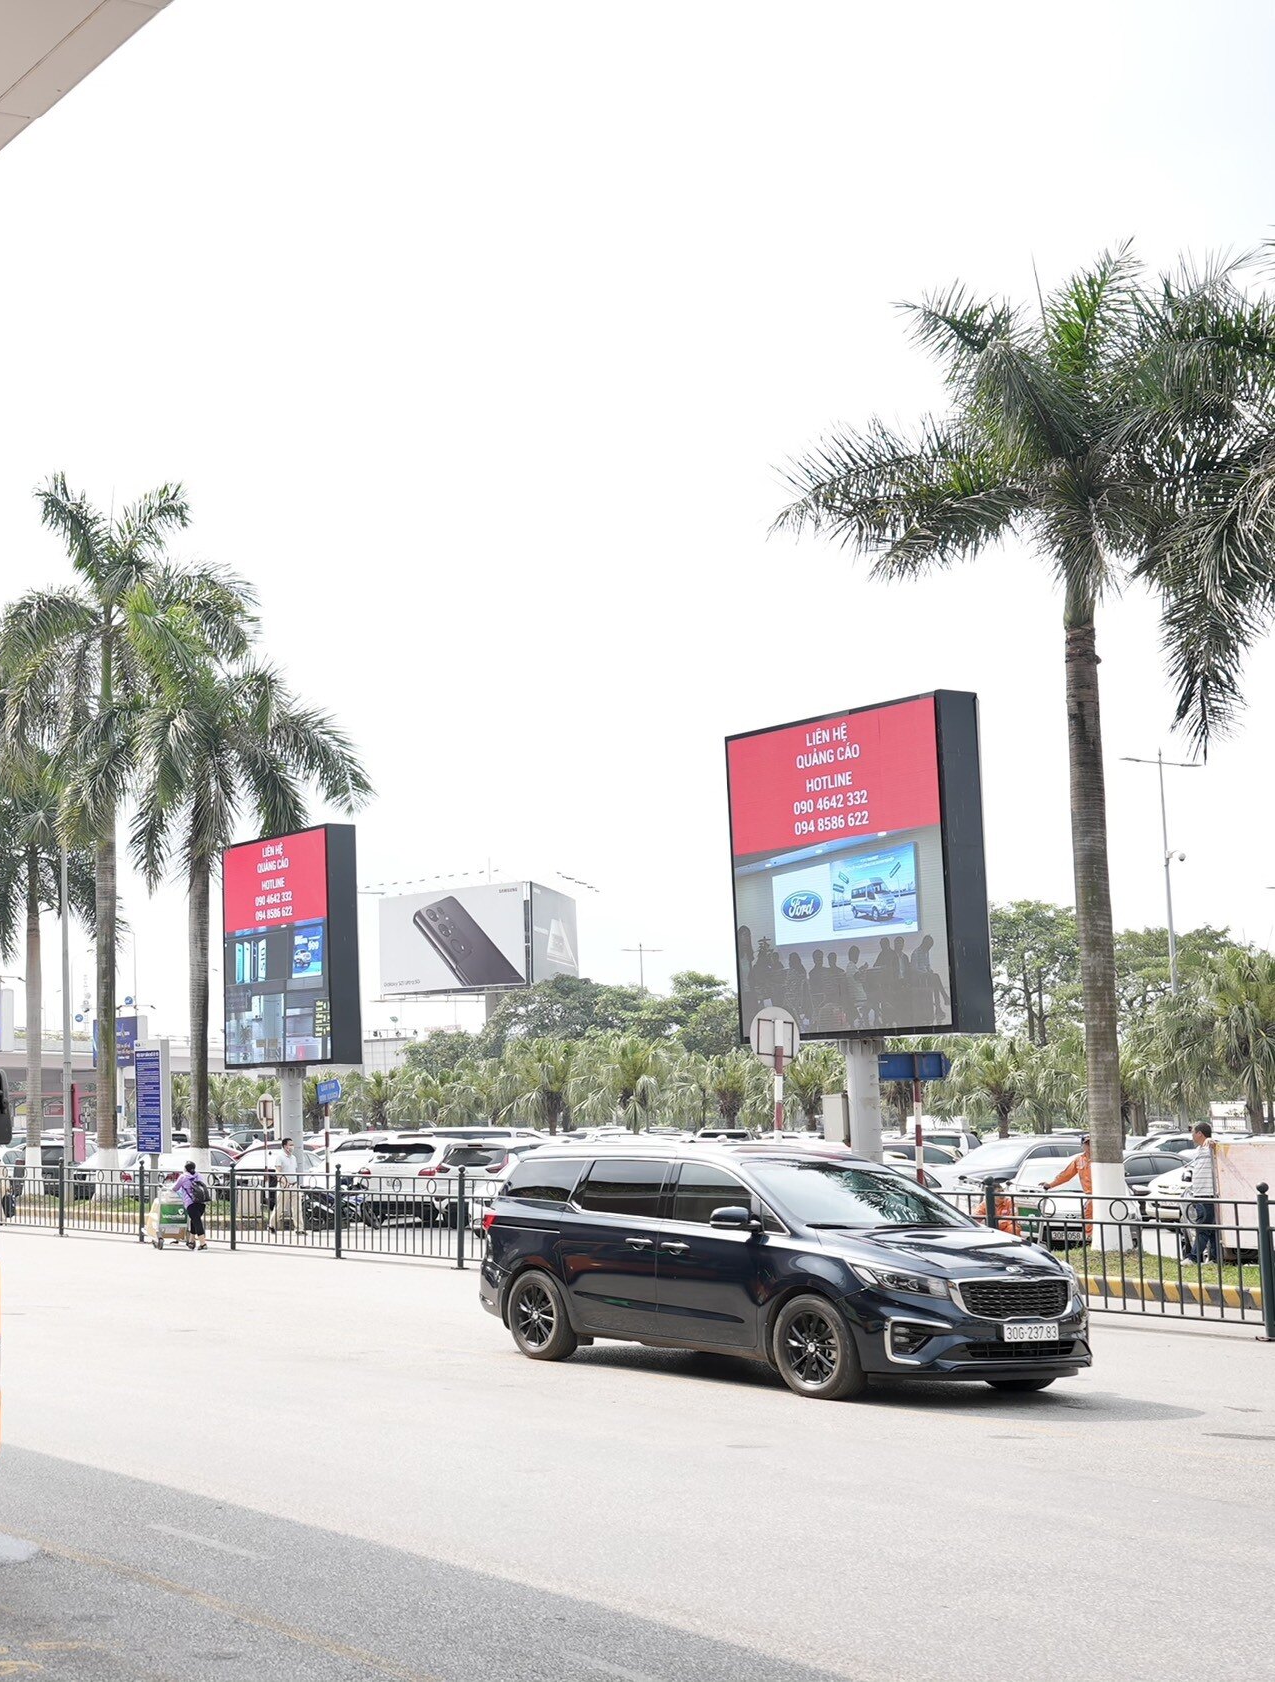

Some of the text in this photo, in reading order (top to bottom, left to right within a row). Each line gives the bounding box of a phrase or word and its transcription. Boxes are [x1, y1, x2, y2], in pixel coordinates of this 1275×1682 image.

[806, 722, 847, 746] LIÊN HỆ
[796, 742, 860, 769] QUẢNG CÁO
[806, 771, 852, 792] HOTLINE
[794, 790, 868, 815] 090 4642 332
[795, 811, 869, 835] 094 8586 622
[261, 877, 285, 891] HOTLINE
[788, 896, 814, 917] Ford
